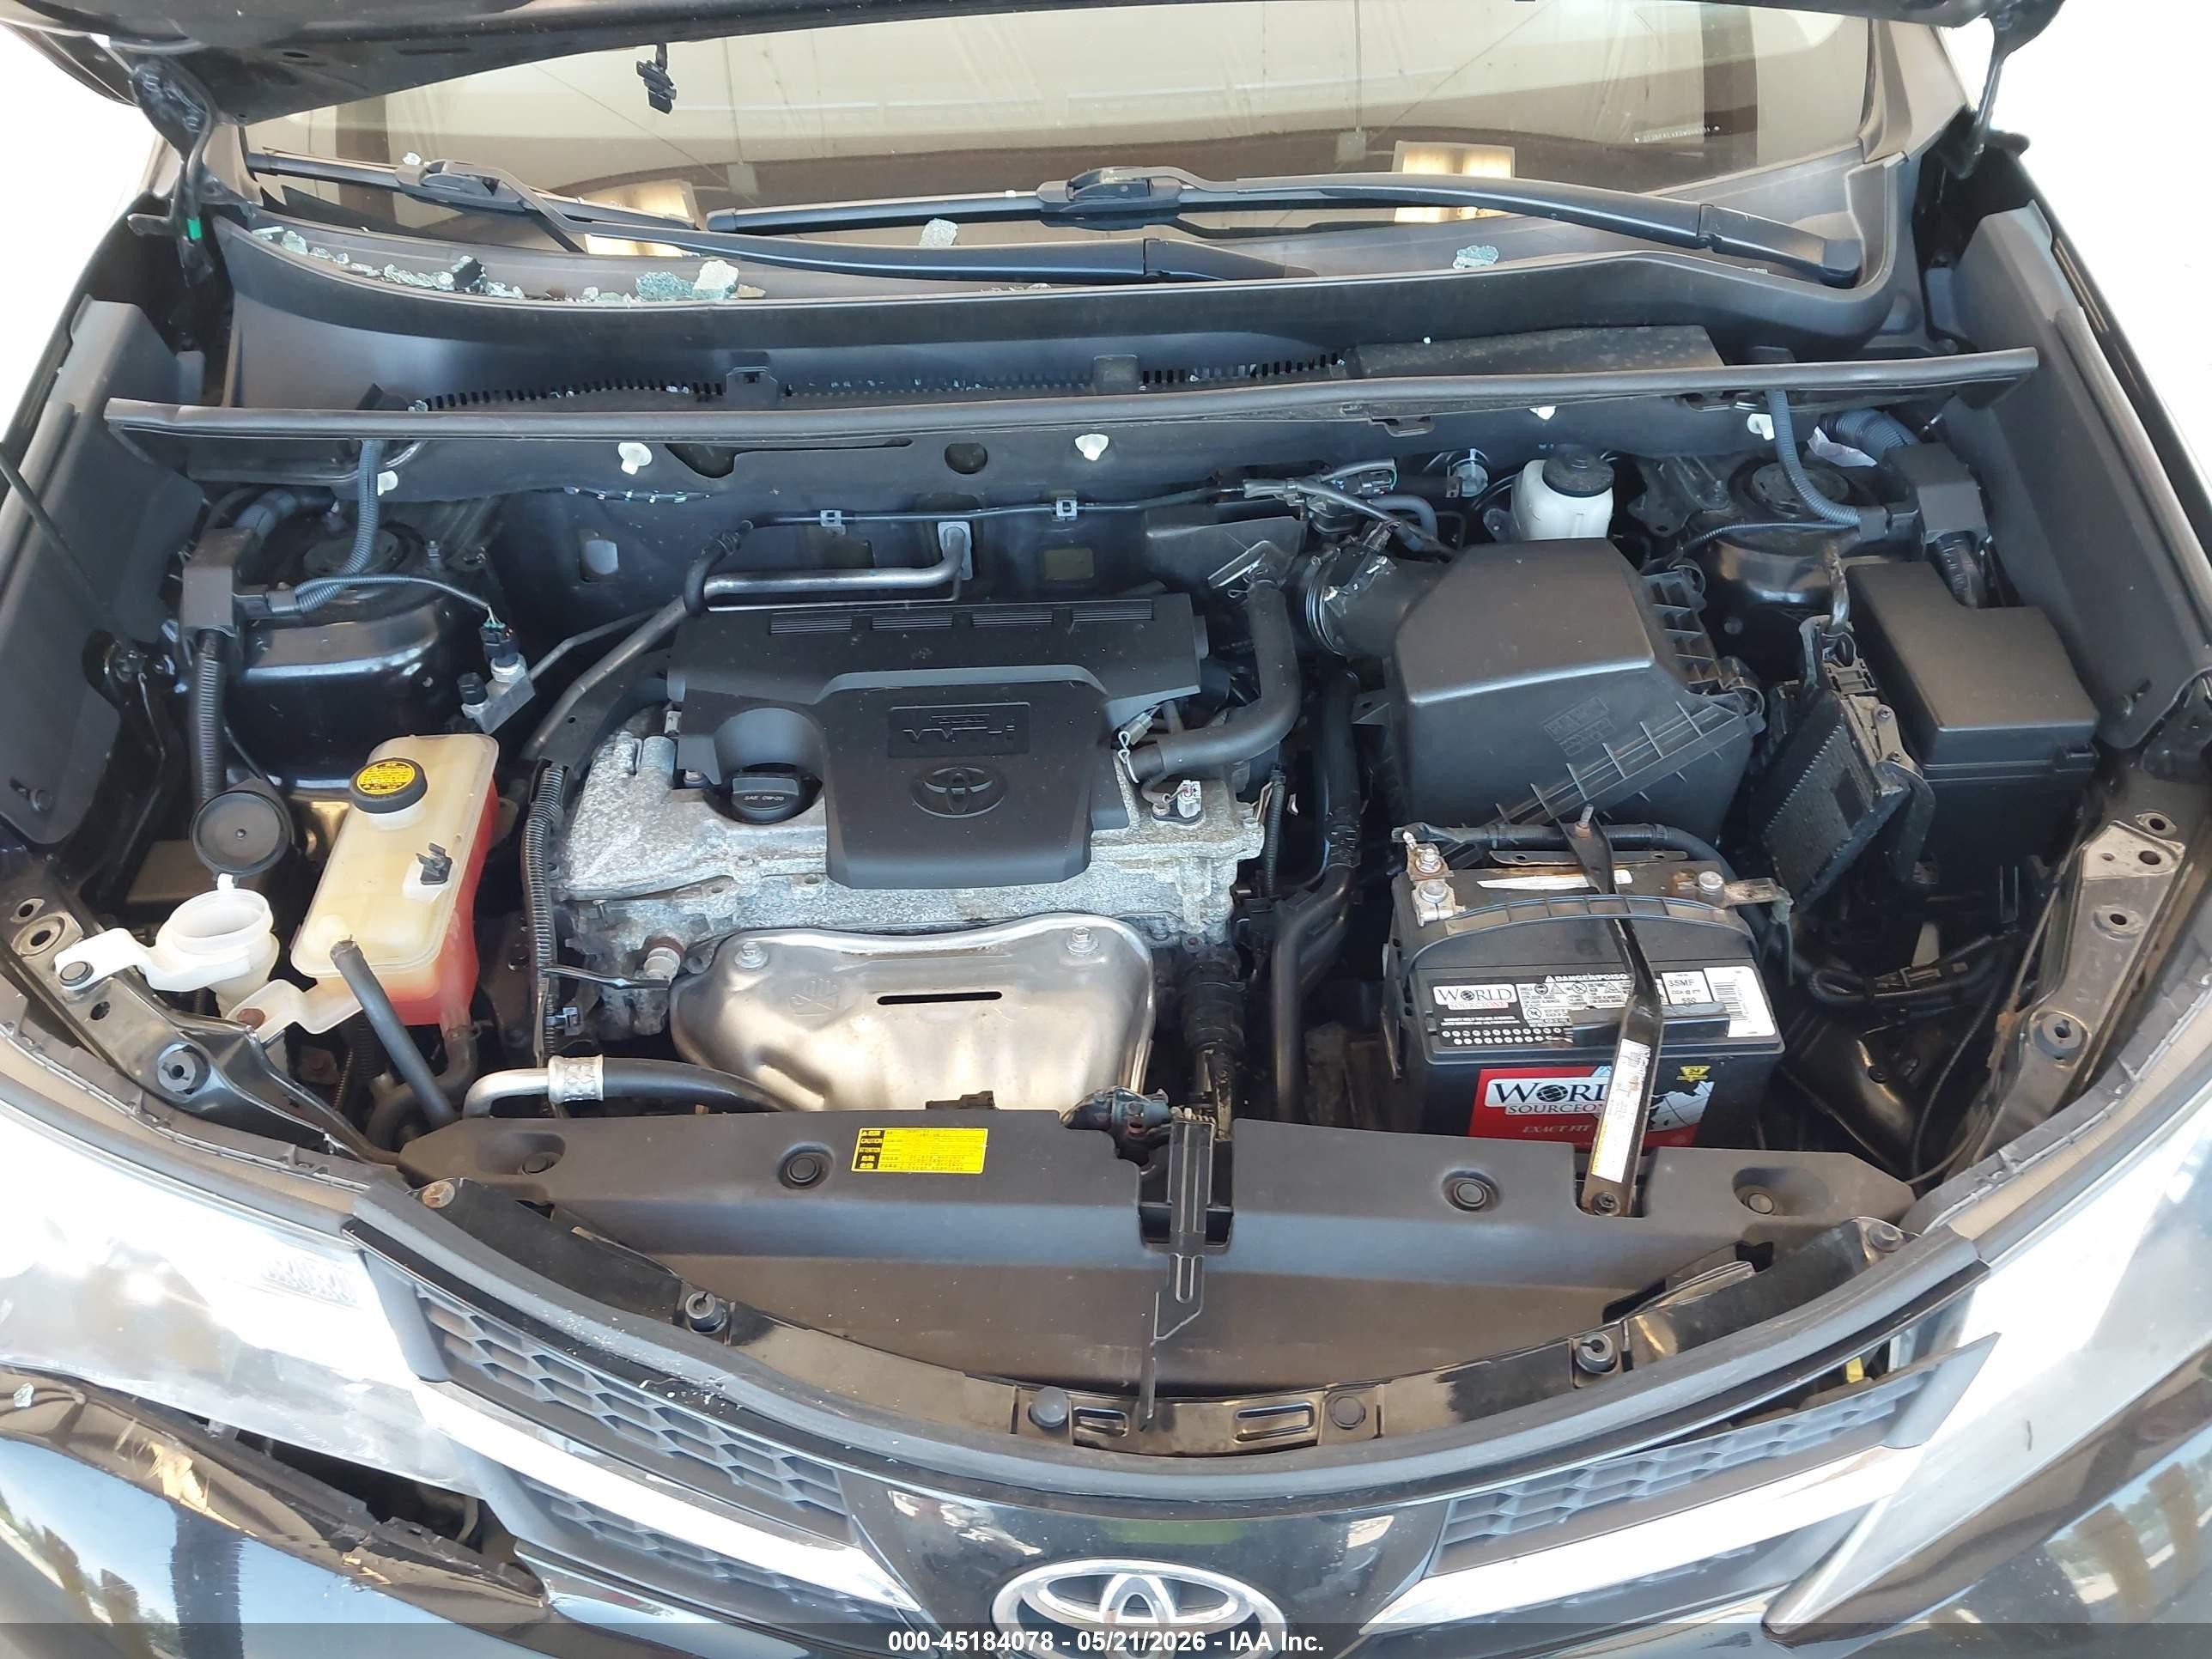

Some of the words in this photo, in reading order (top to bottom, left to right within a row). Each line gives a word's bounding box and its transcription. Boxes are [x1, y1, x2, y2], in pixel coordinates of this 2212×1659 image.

[1436, 988, 1512, 1001] WORLD
[1492, 1082, 1608, 1103] WORL
[1509, 1103, 1603, 1114] SOURCEO
